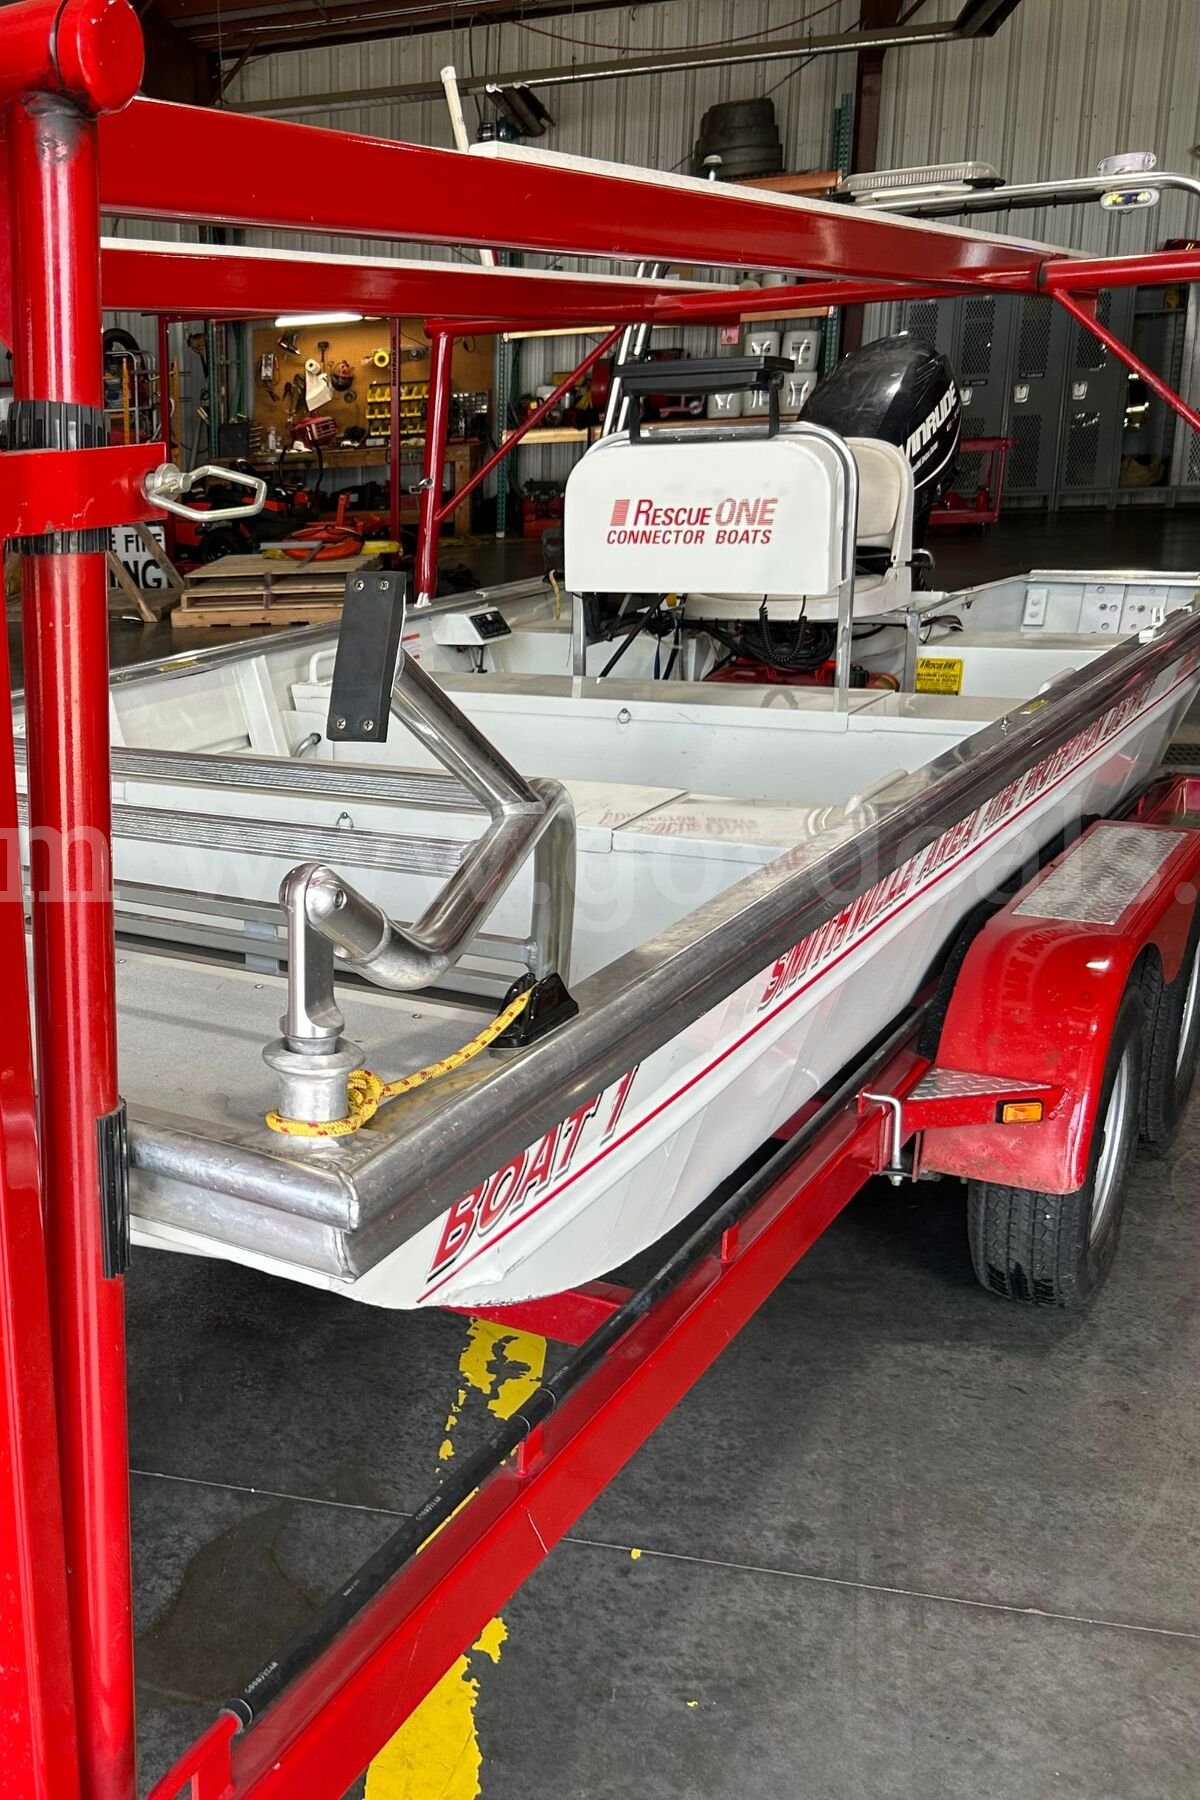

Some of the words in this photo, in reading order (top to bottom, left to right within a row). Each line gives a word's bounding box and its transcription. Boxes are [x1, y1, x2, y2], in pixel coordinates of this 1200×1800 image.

[899, 380, 957, 460] VINRUDE
[606, 529, 705, 545] CONNECTOR
[715, 529, 772, 545] BOATS
[715, 498, 779, 526] ONE
[426, 1092, 604, 1283] BOAT
